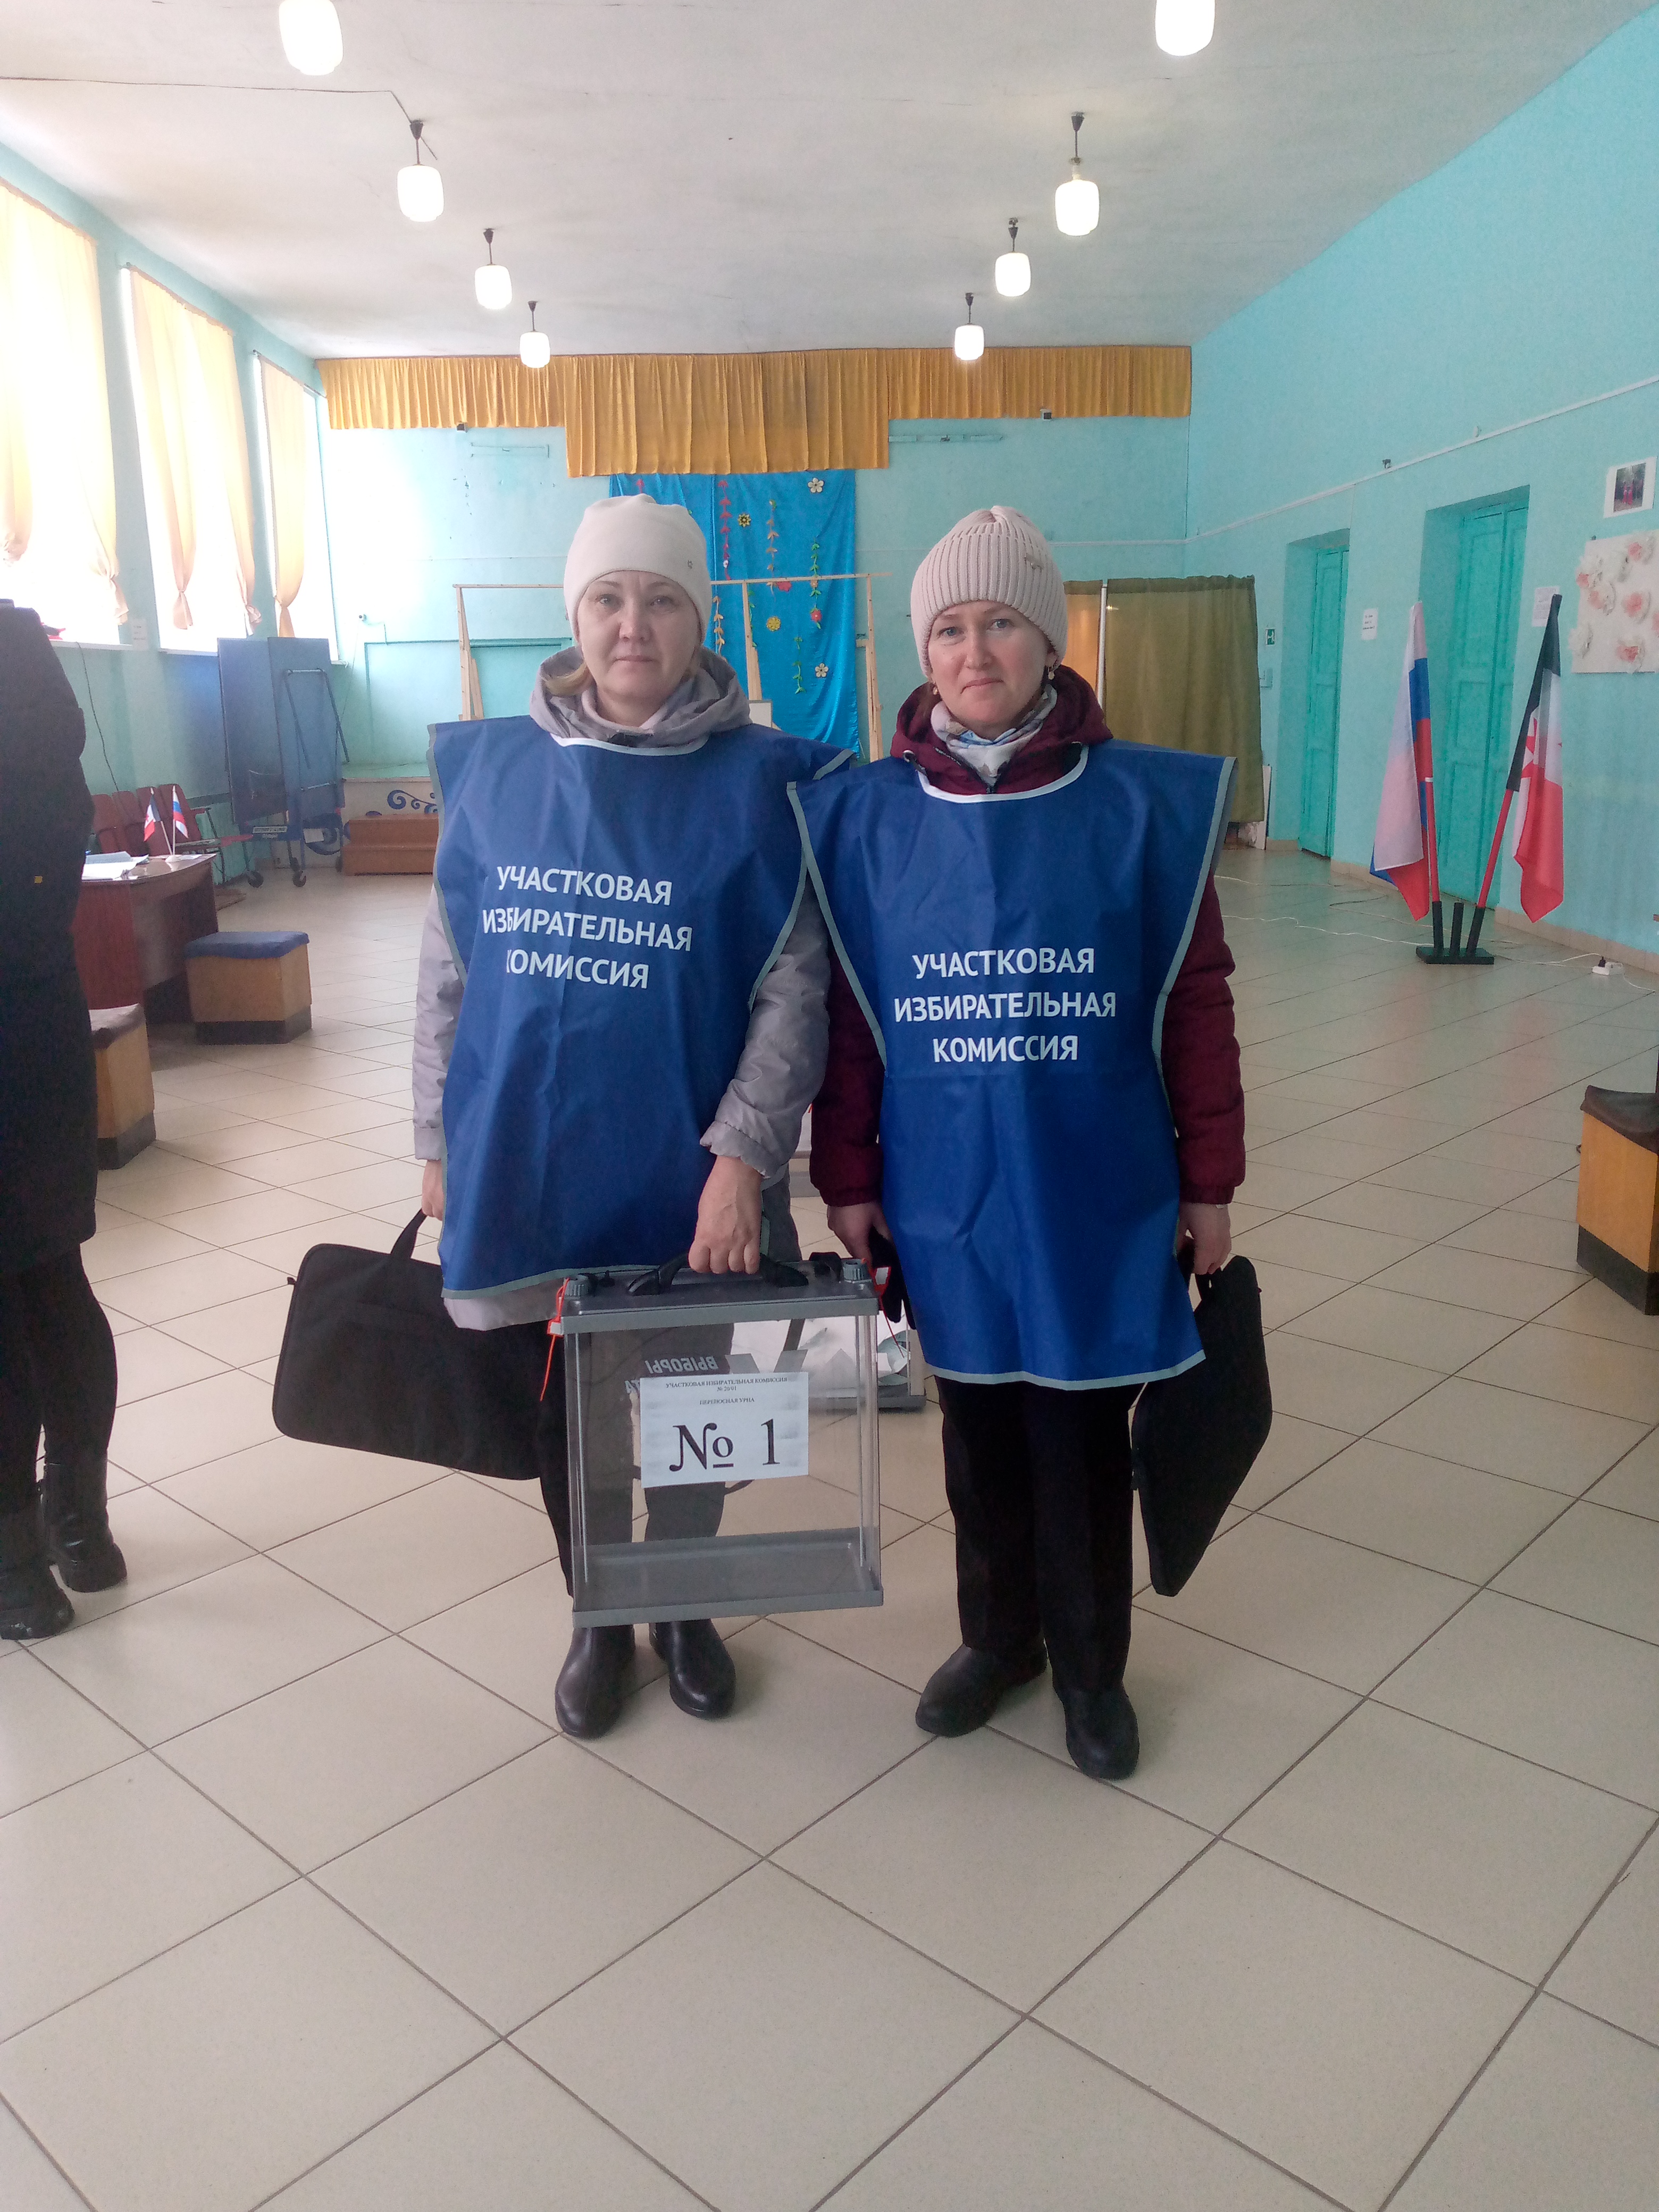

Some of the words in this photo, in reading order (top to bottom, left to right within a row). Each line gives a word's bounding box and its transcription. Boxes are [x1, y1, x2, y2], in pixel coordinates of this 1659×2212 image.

[497, 865, 673, 906] УЧАСТКОВАЯ
[482, 907, 693, 952] ИЗБИРАТЕЛЬНАЯ
[912, 947, 1095, 979] УЧАСТКОВАЯ
[894, 991, 1117, 1023] ИЗБИРАТЕЛЬНАЯ
[933, 1035, 1079, 1063] КОМИССИЯ
[761, 1419, 780, 1465] 1
